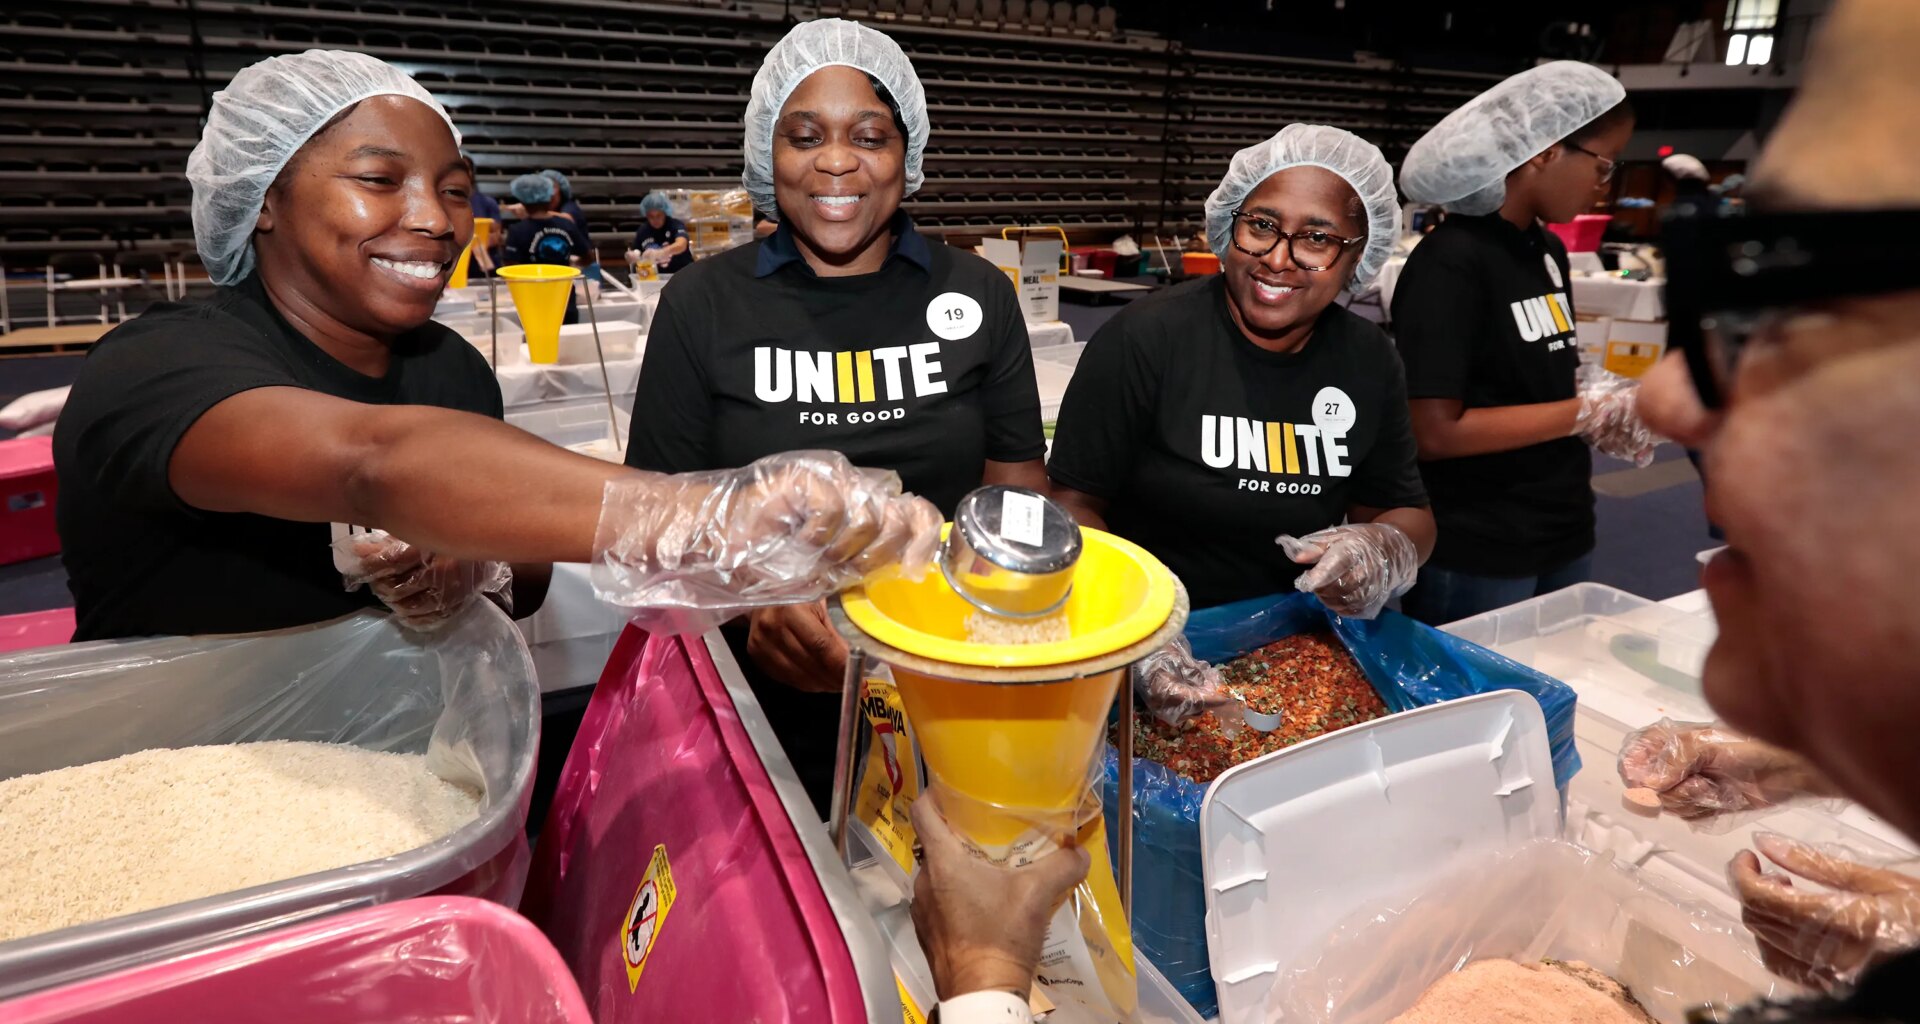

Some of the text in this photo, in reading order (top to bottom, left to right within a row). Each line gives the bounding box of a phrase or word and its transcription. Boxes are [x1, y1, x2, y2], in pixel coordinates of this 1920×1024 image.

[944, 308, 964, 321] 19
[1548, 340, 1566, 352] FOR
[754, 341, 949, 404] UNIITE
[799, 407, 906, 425] FOR GOOD
[1324, 402, 1340, 415] 27
[1201, 414, 1352, 477] UNIITE
[1238, 478, 1322, 495] FOR GOOD
